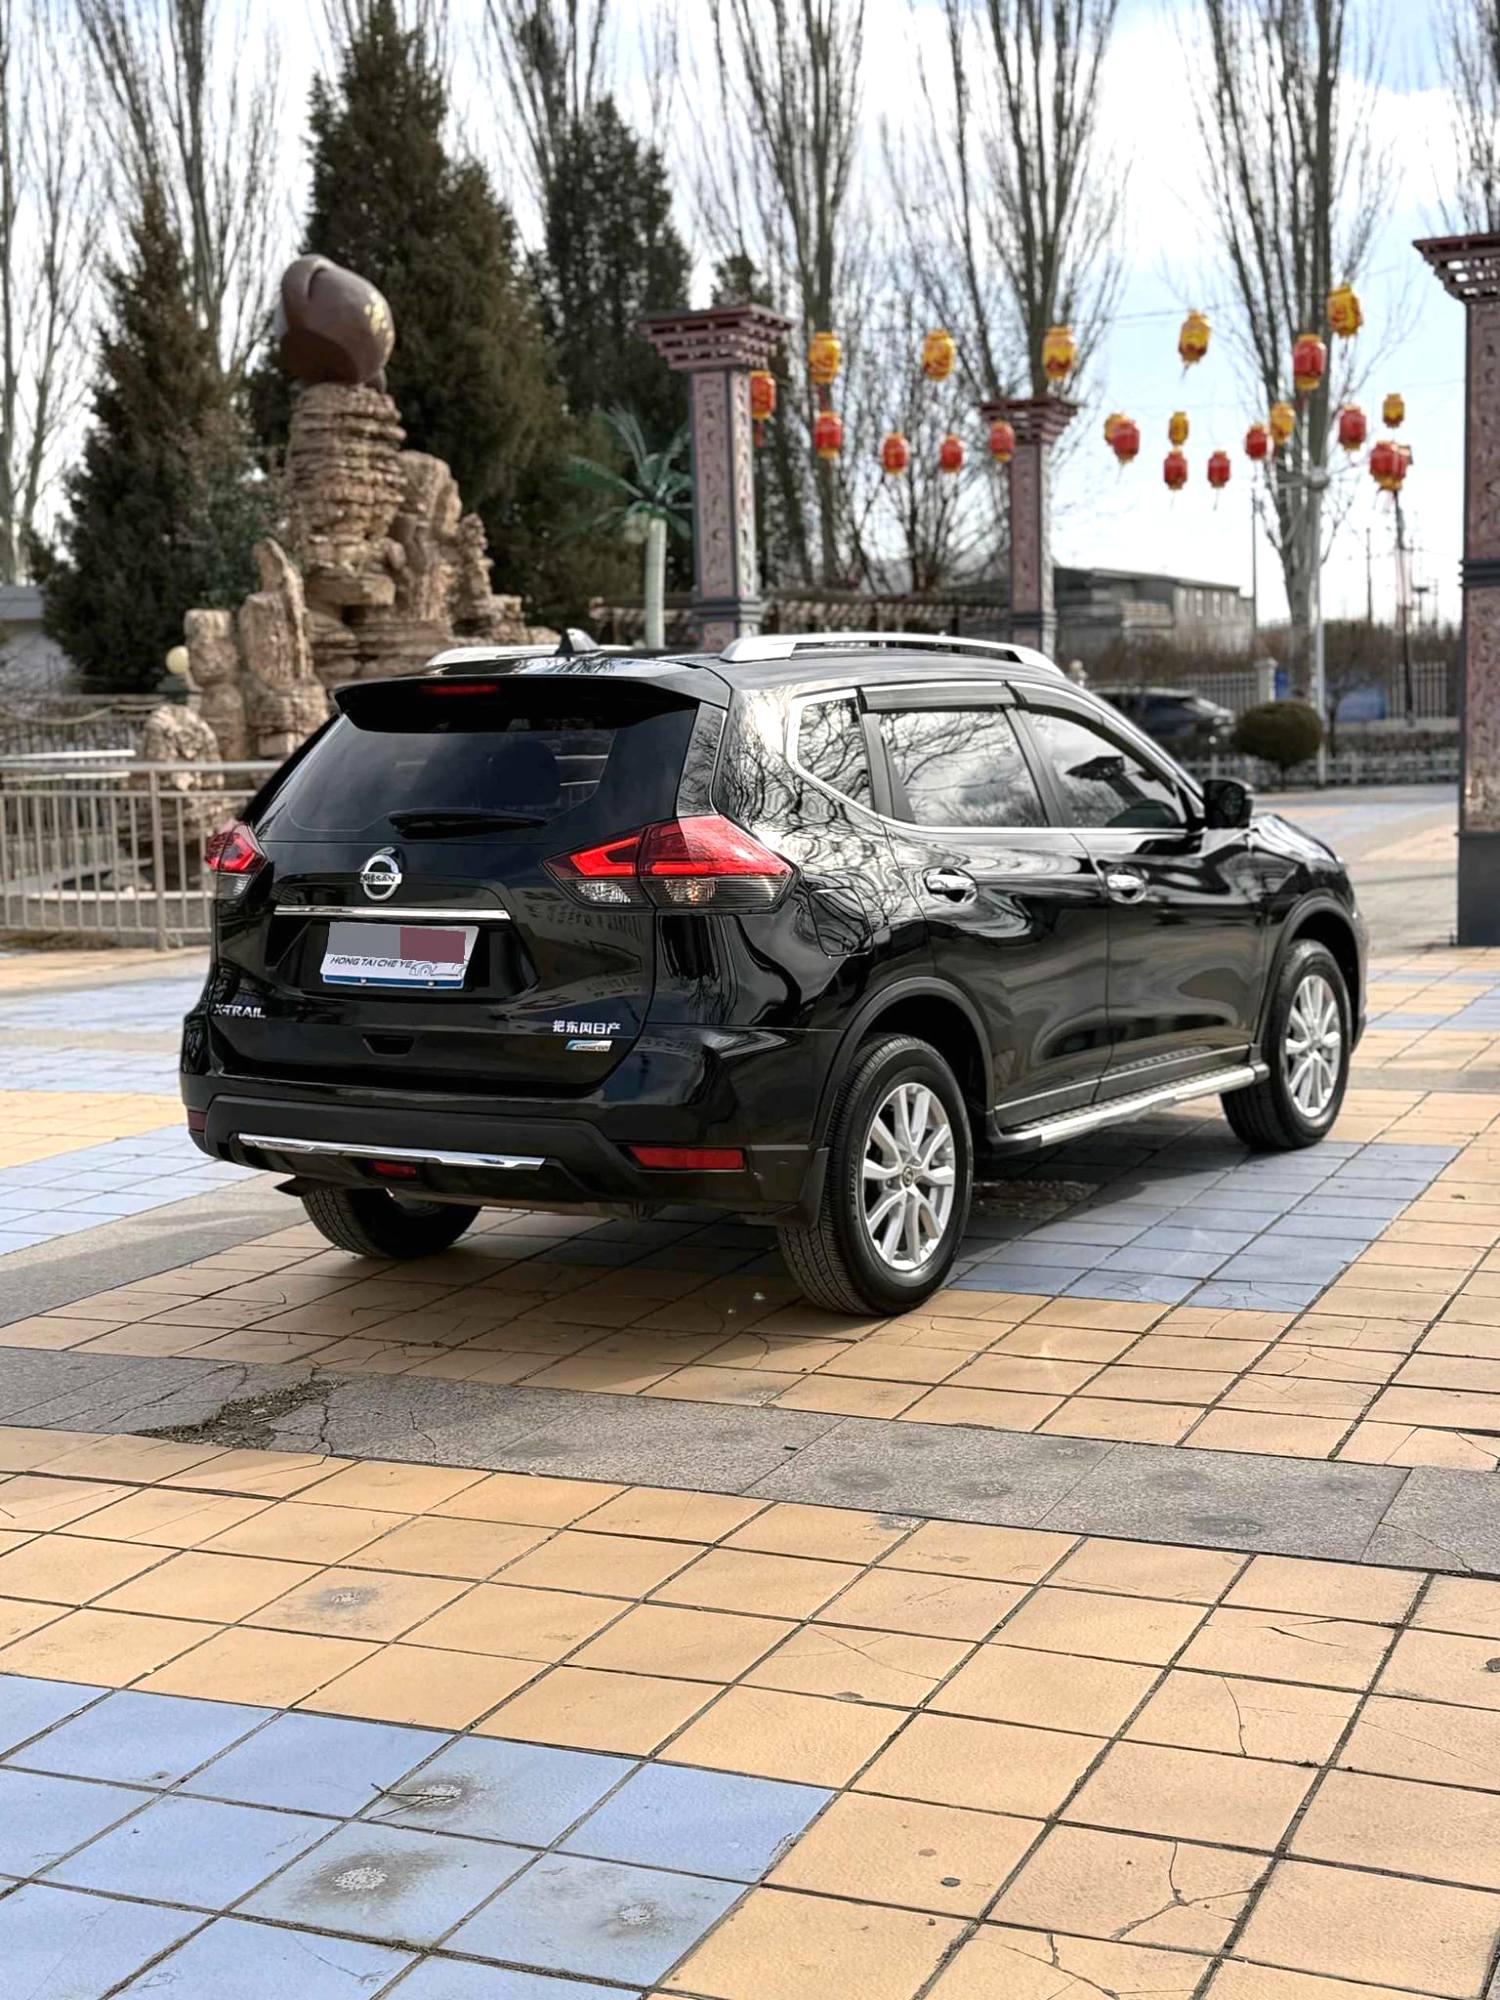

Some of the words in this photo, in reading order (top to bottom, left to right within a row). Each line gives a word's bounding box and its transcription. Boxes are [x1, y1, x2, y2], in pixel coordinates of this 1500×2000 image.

[330, 957, 360, 966] HONG
[361, 958, 377, 967] TAI
[377, 959, 398, 968] CHE
[213, 1003, 267, 1019] X-TRAIL
